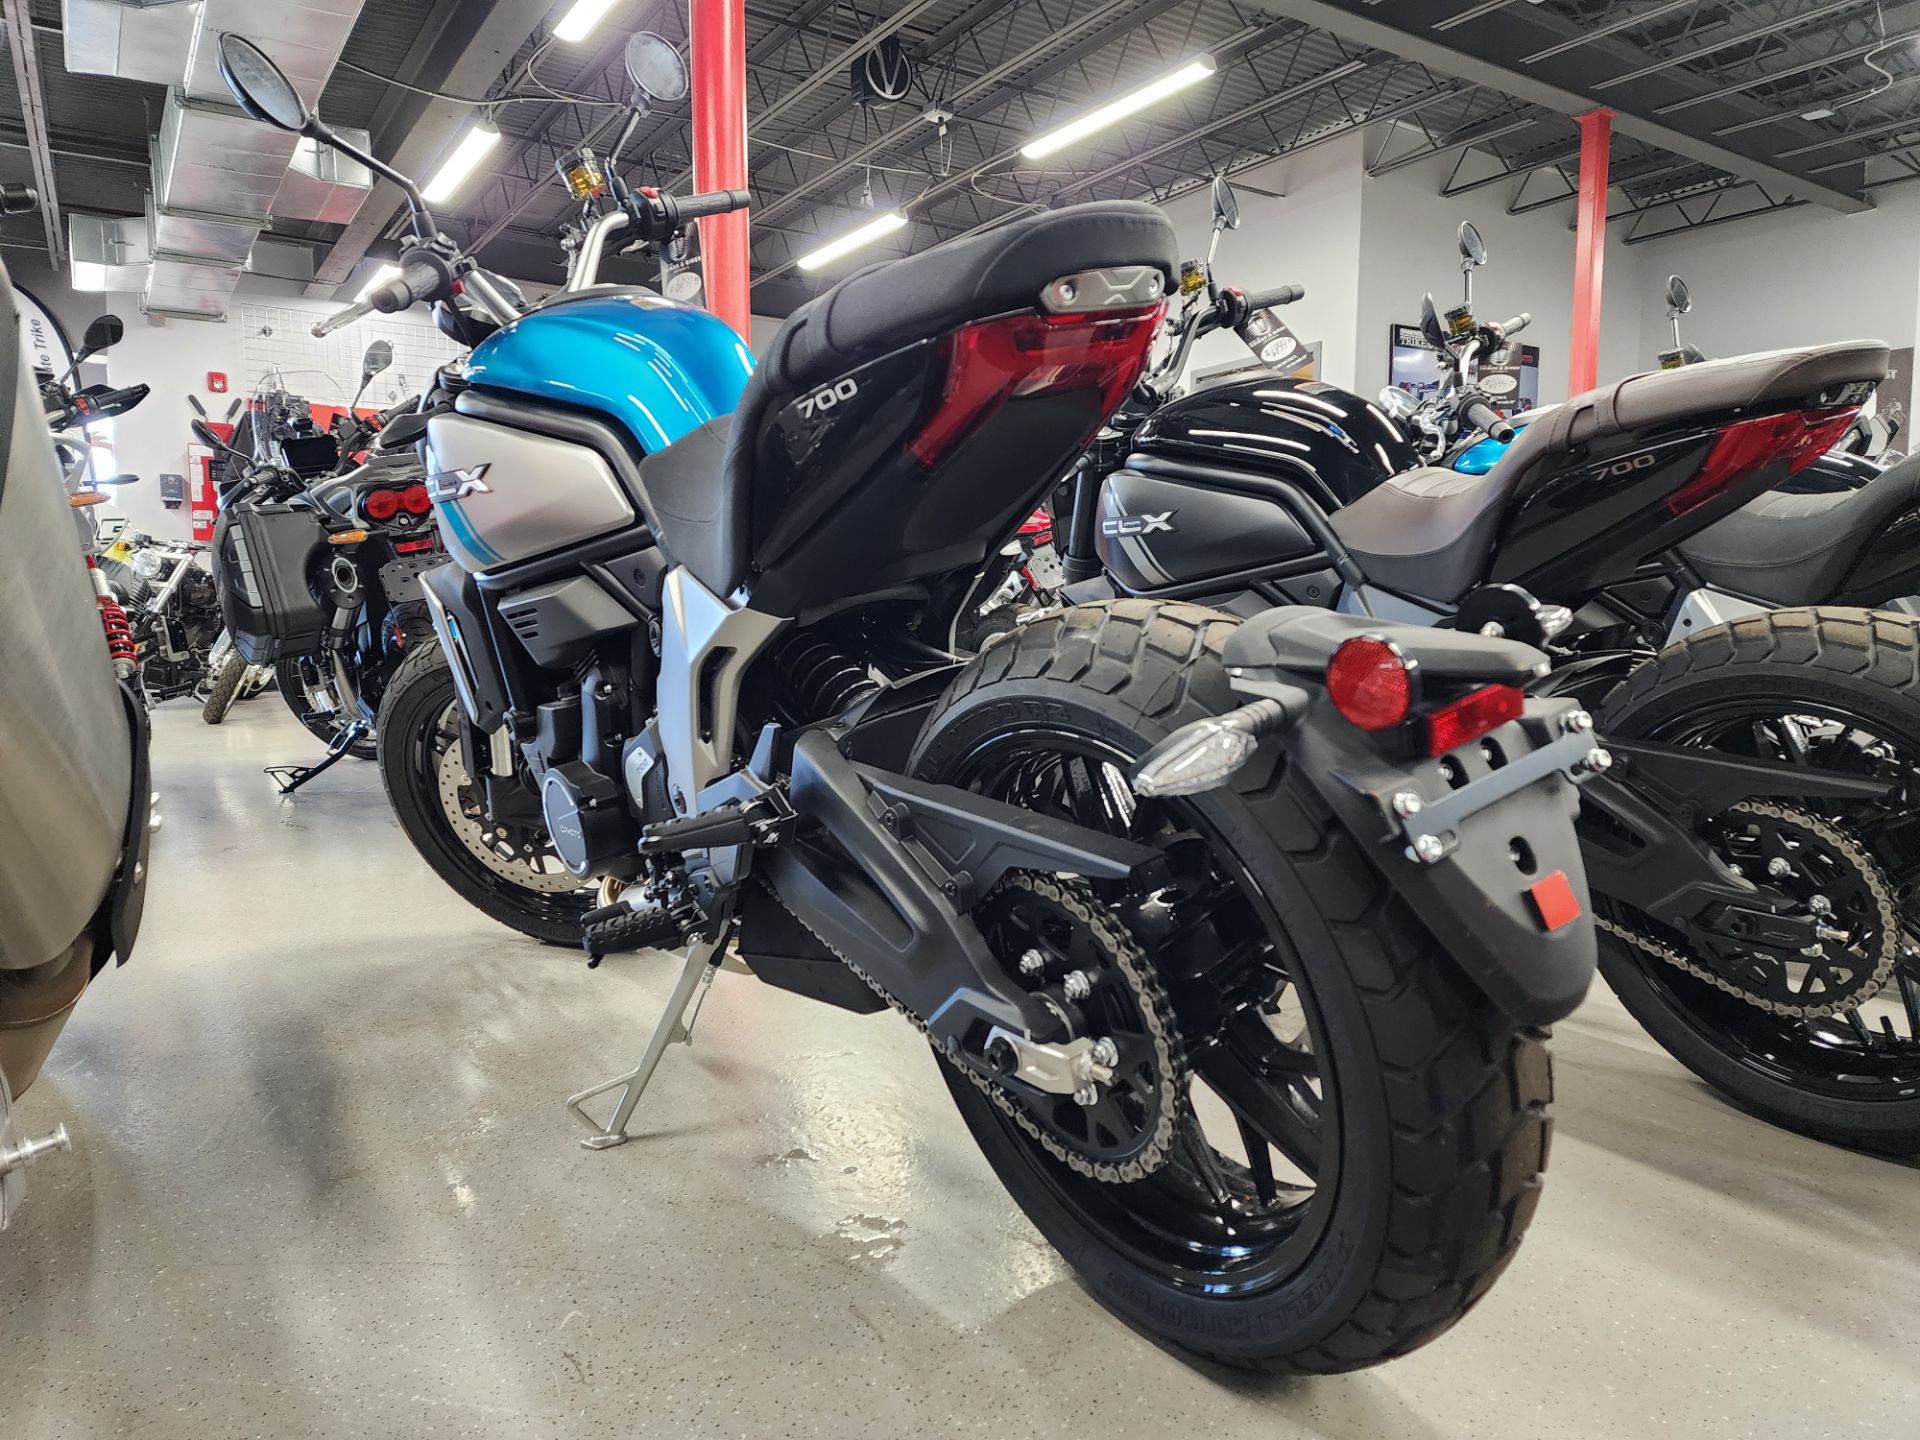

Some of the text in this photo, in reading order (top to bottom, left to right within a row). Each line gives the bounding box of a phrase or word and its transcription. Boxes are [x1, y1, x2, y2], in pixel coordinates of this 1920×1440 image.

[30, 318, 48, 351] Trike
[797, 378, 858, 419] 700
[1590, 454, 1655, 481] 700
[1102, 511, 1174, 535] CLX
[636, 758, 650, 775] 700
